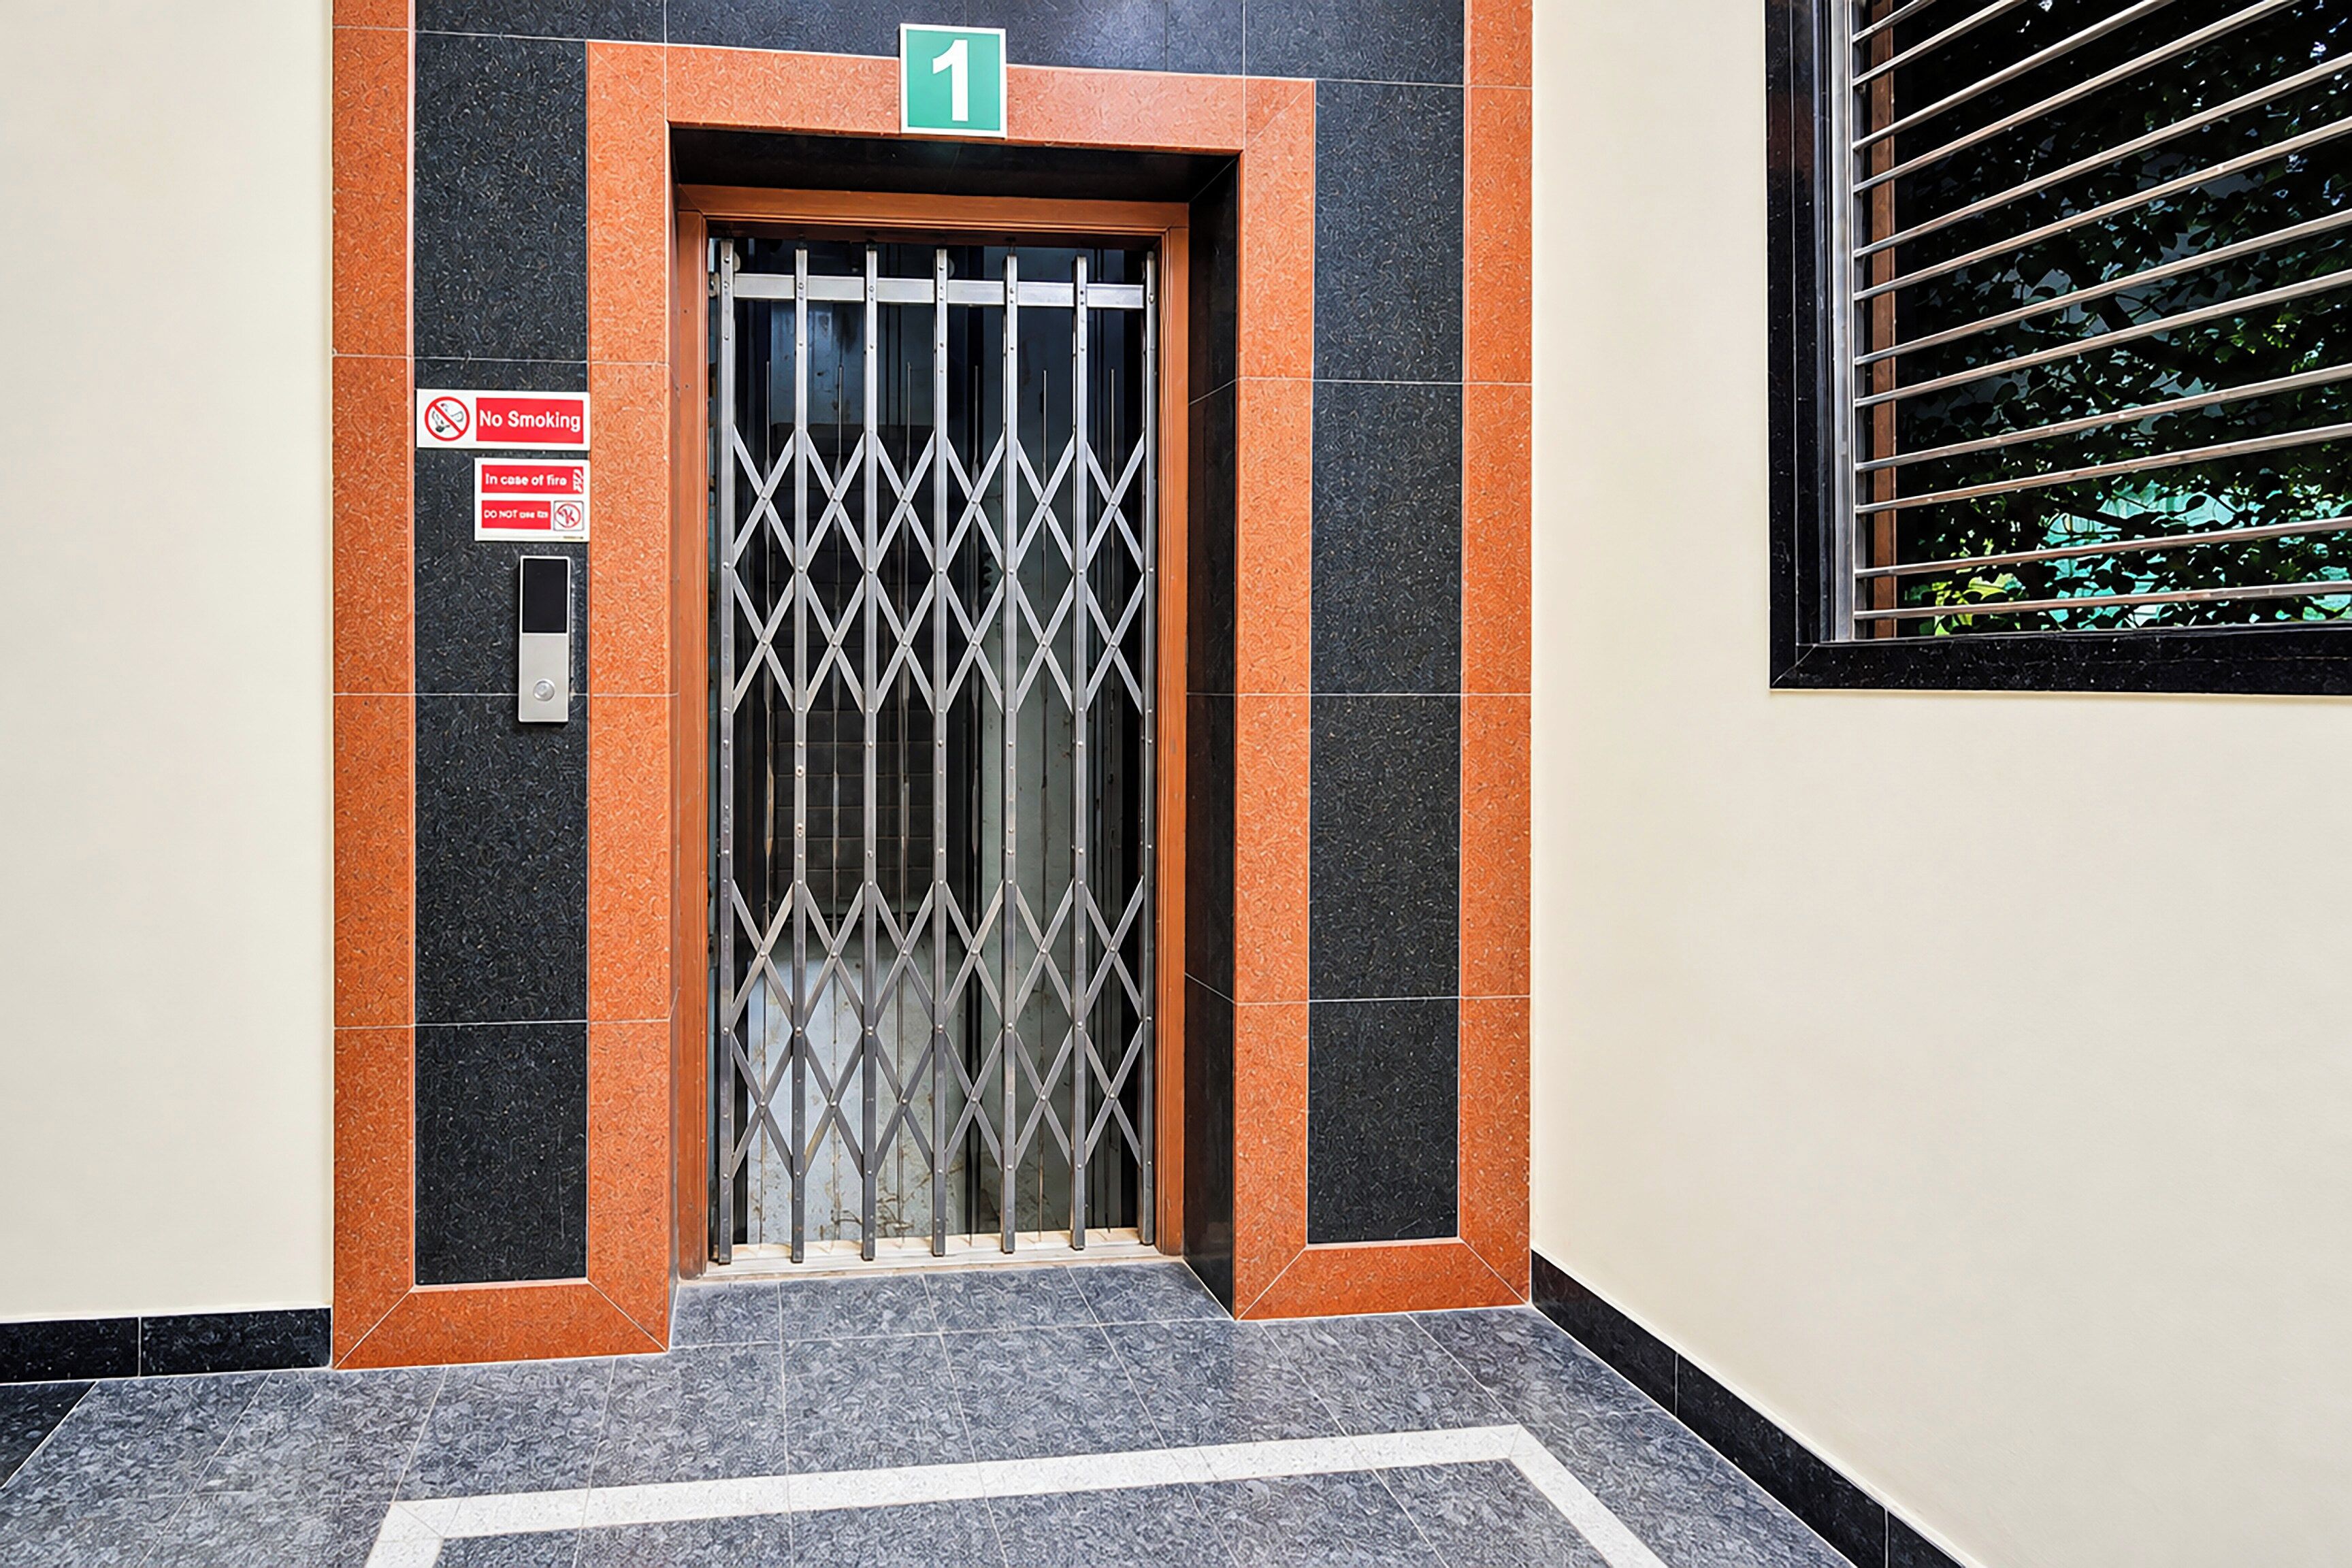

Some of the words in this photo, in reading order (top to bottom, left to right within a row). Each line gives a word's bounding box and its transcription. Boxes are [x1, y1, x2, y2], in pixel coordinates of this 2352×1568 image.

[932, 39, 968, 121] 1
[479, 410, 503, 427] No
[508, 410, 581, 433] Smoking
[485, 473, 498, 485] In
[500, 476, 529, 486] case
[531, 474, 544, 486] of
[546, 474, 567, 486] fire
[484, 510, 497, 519] DO
[499, 509, 518, 519] NOT
